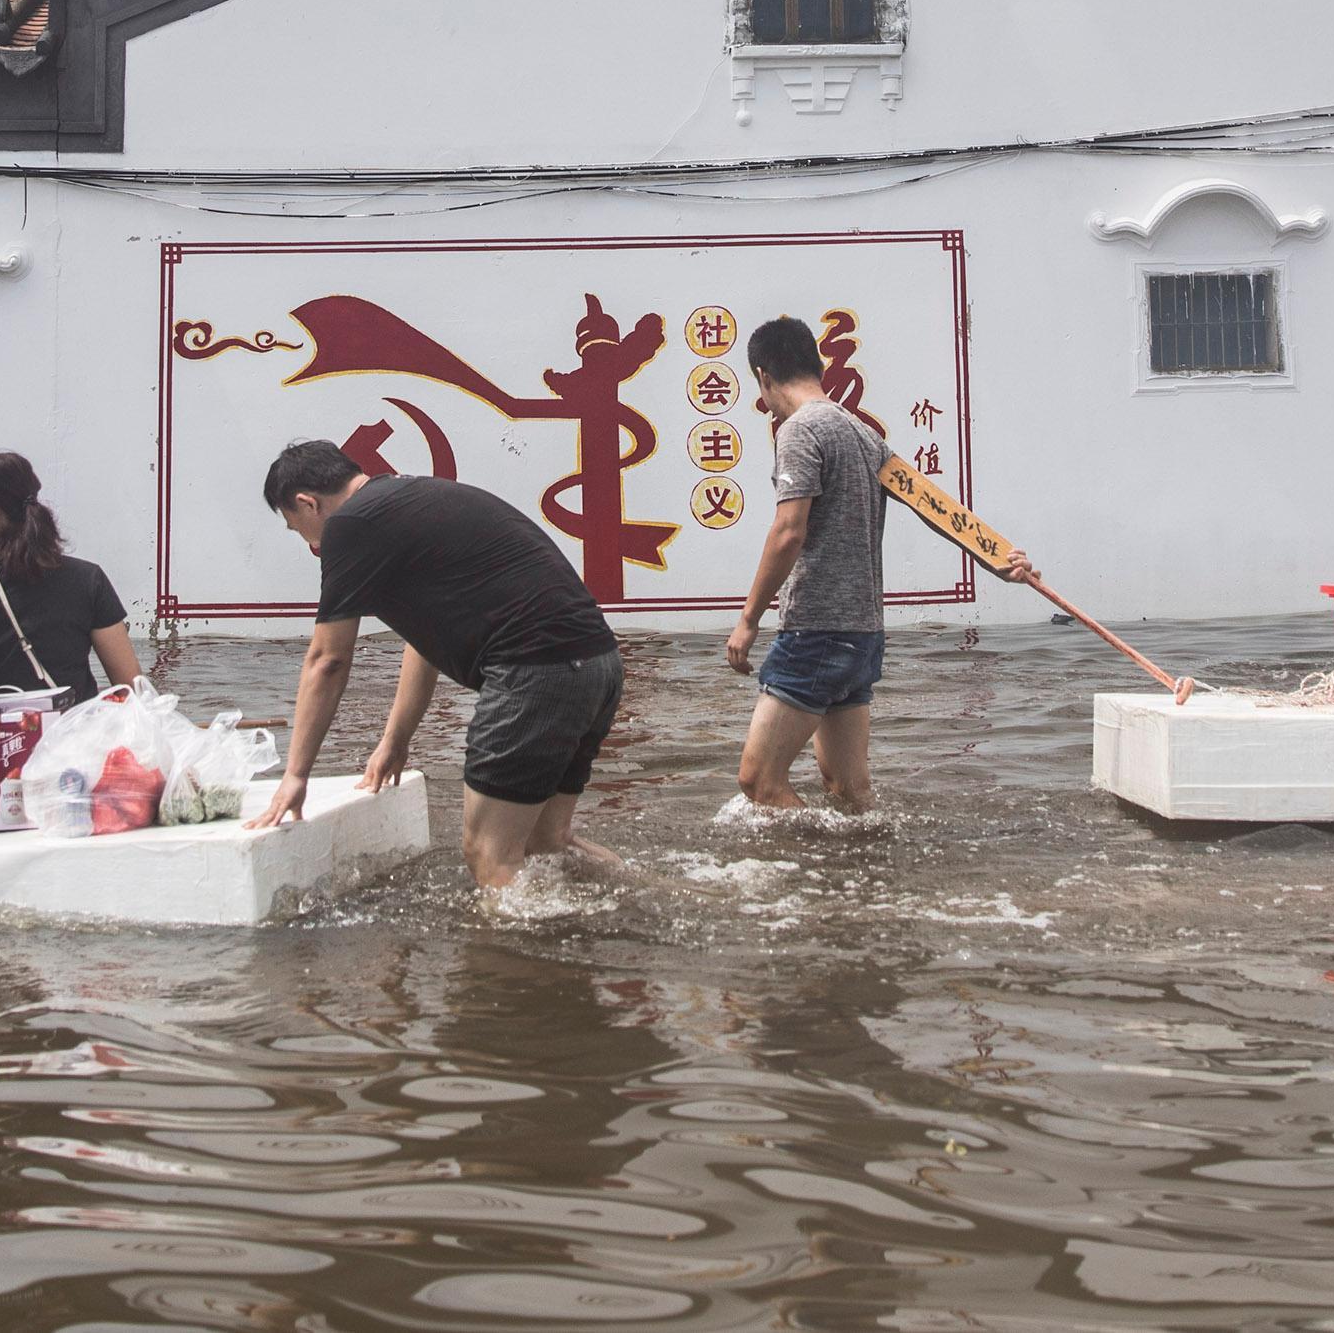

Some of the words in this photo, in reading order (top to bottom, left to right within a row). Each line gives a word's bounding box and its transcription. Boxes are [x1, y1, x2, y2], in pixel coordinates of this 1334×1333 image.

[695, 315, 735, 520] 社会主义
[910, 399, 943, 475] 价值
[889, 469, 999, 556] 劳动光荣
